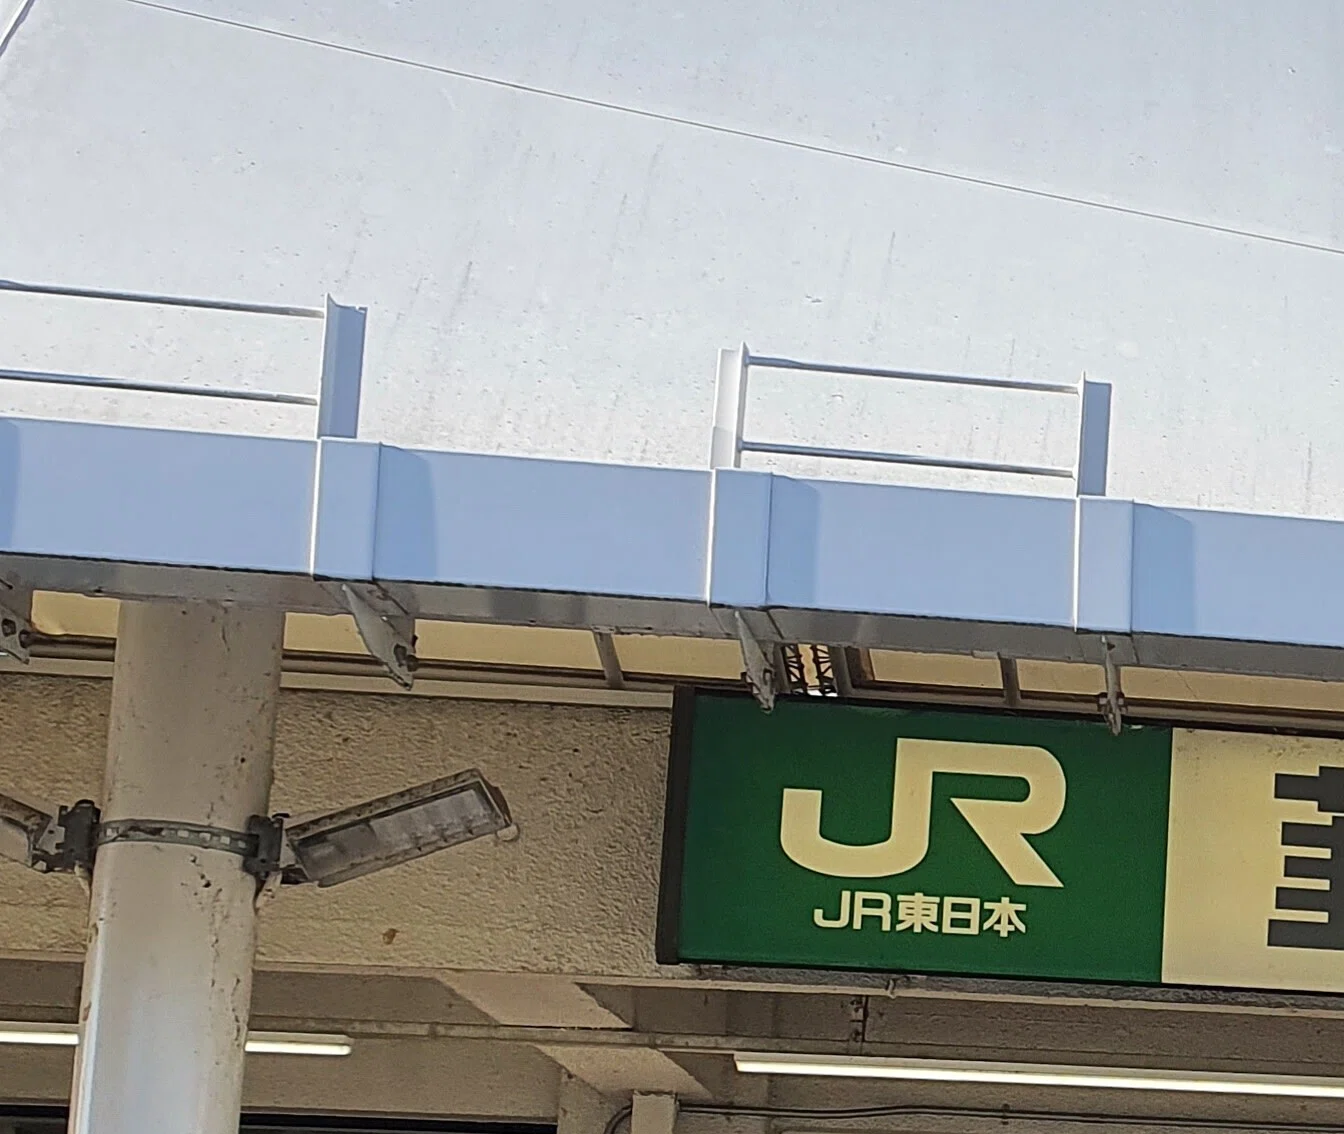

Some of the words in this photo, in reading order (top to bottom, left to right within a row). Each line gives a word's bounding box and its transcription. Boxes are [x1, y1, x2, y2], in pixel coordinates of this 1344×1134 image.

[781, 738, 1067, 888] JR
[813, 890, 1028, 938] JR東日本
